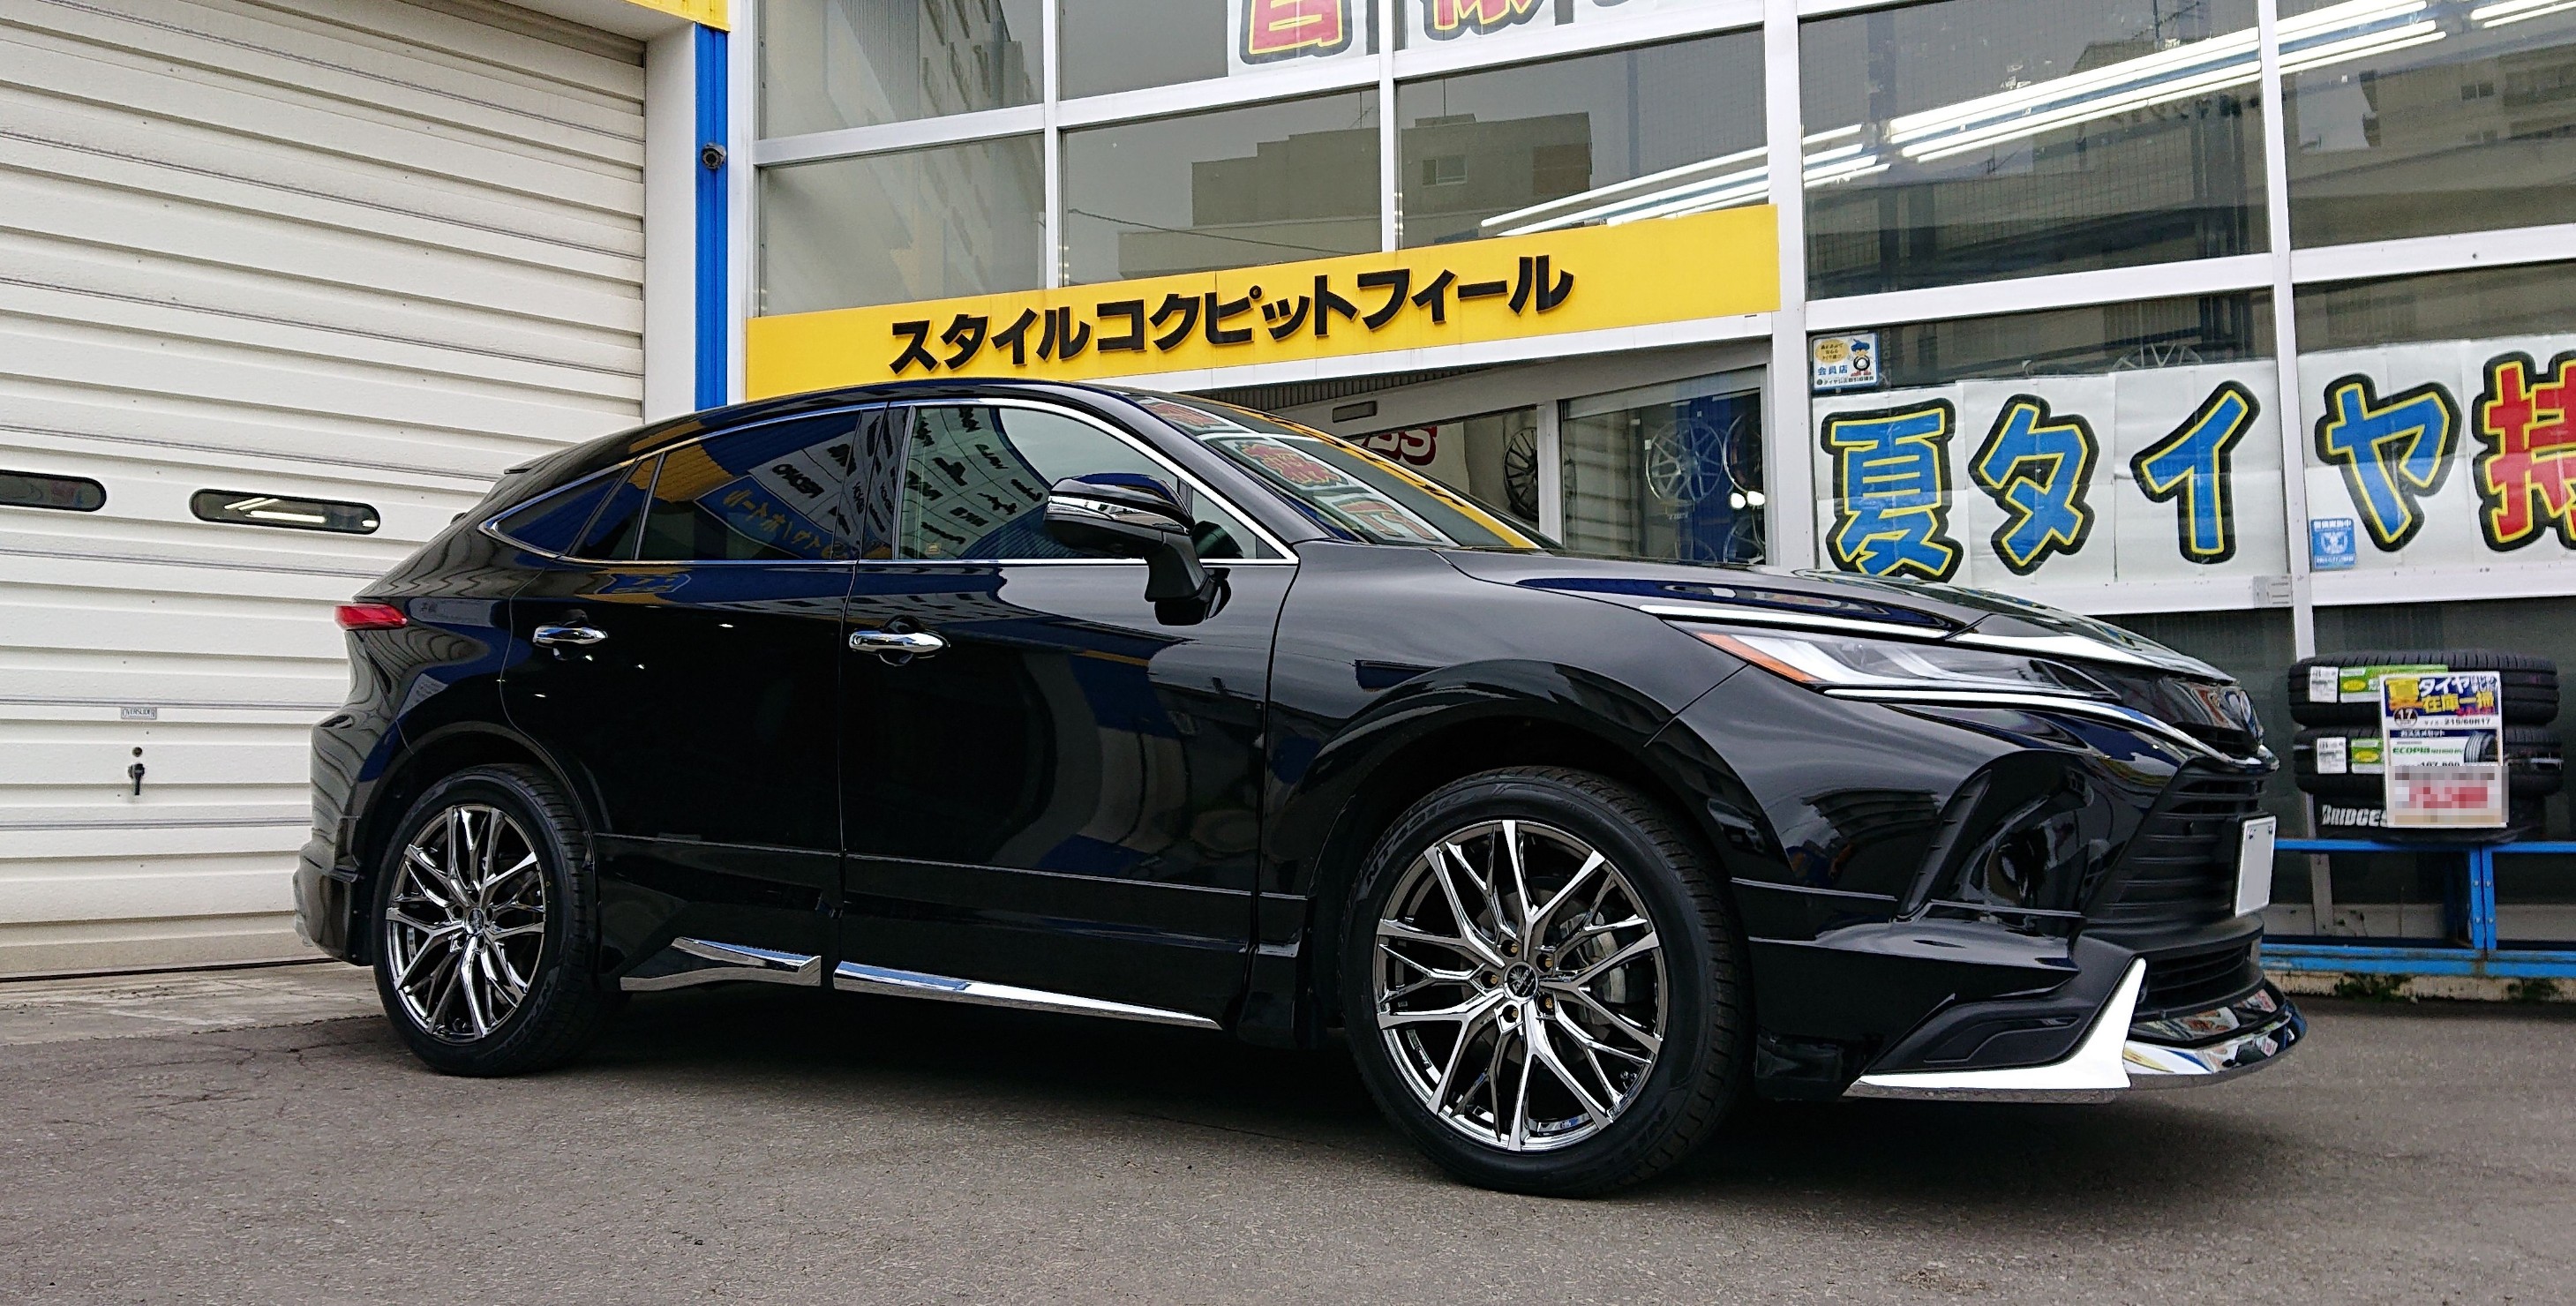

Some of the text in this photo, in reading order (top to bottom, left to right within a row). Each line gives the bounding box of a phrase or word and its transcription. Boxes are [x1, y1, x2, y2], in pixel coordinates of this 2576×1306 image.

[890, 255, 1574, 375] スタイルコクピットフィール
[1817, 364, 1848, 376] 会員店
[2398, 709, 2414, 720] 17
